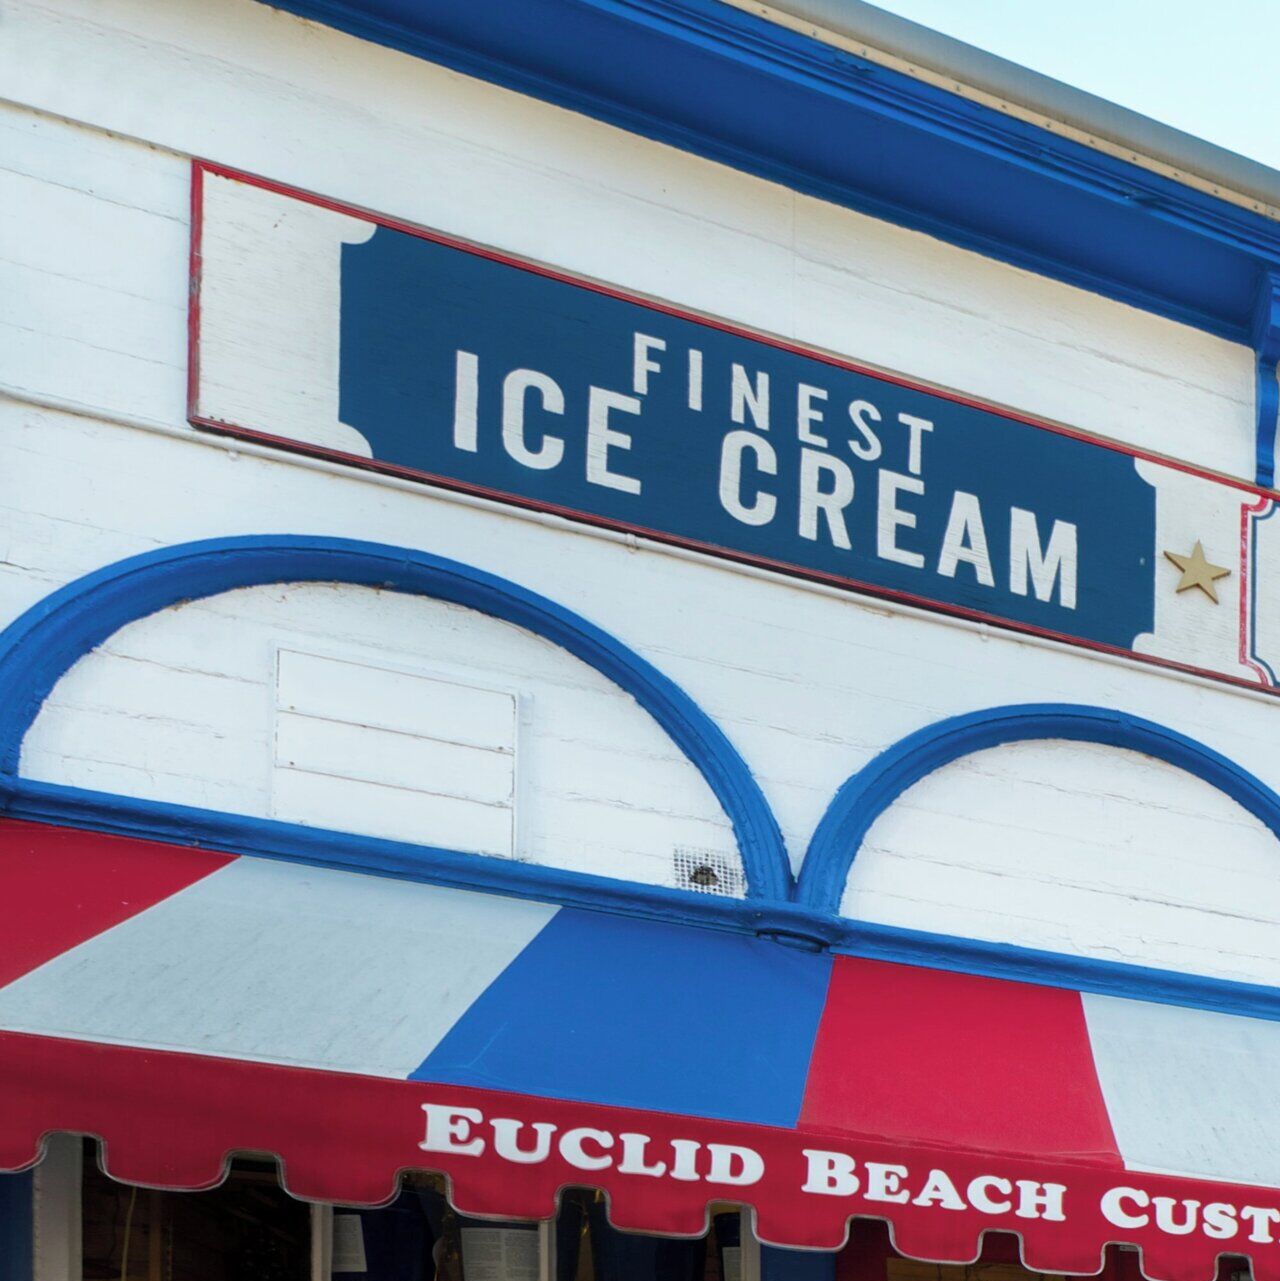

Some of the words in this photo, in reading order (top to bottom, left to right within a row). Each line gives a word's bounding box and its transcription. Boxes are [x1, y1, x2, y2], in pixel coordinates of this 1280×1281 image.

[633, 332, 933, 476] FINEST
[452, 349, 643, 496] ICE
[718, 429, 1078, 610] CREAM
[418, 1102, 766, 1187] EUCLID
[800, 1147, 1067, 1222] BEACH
